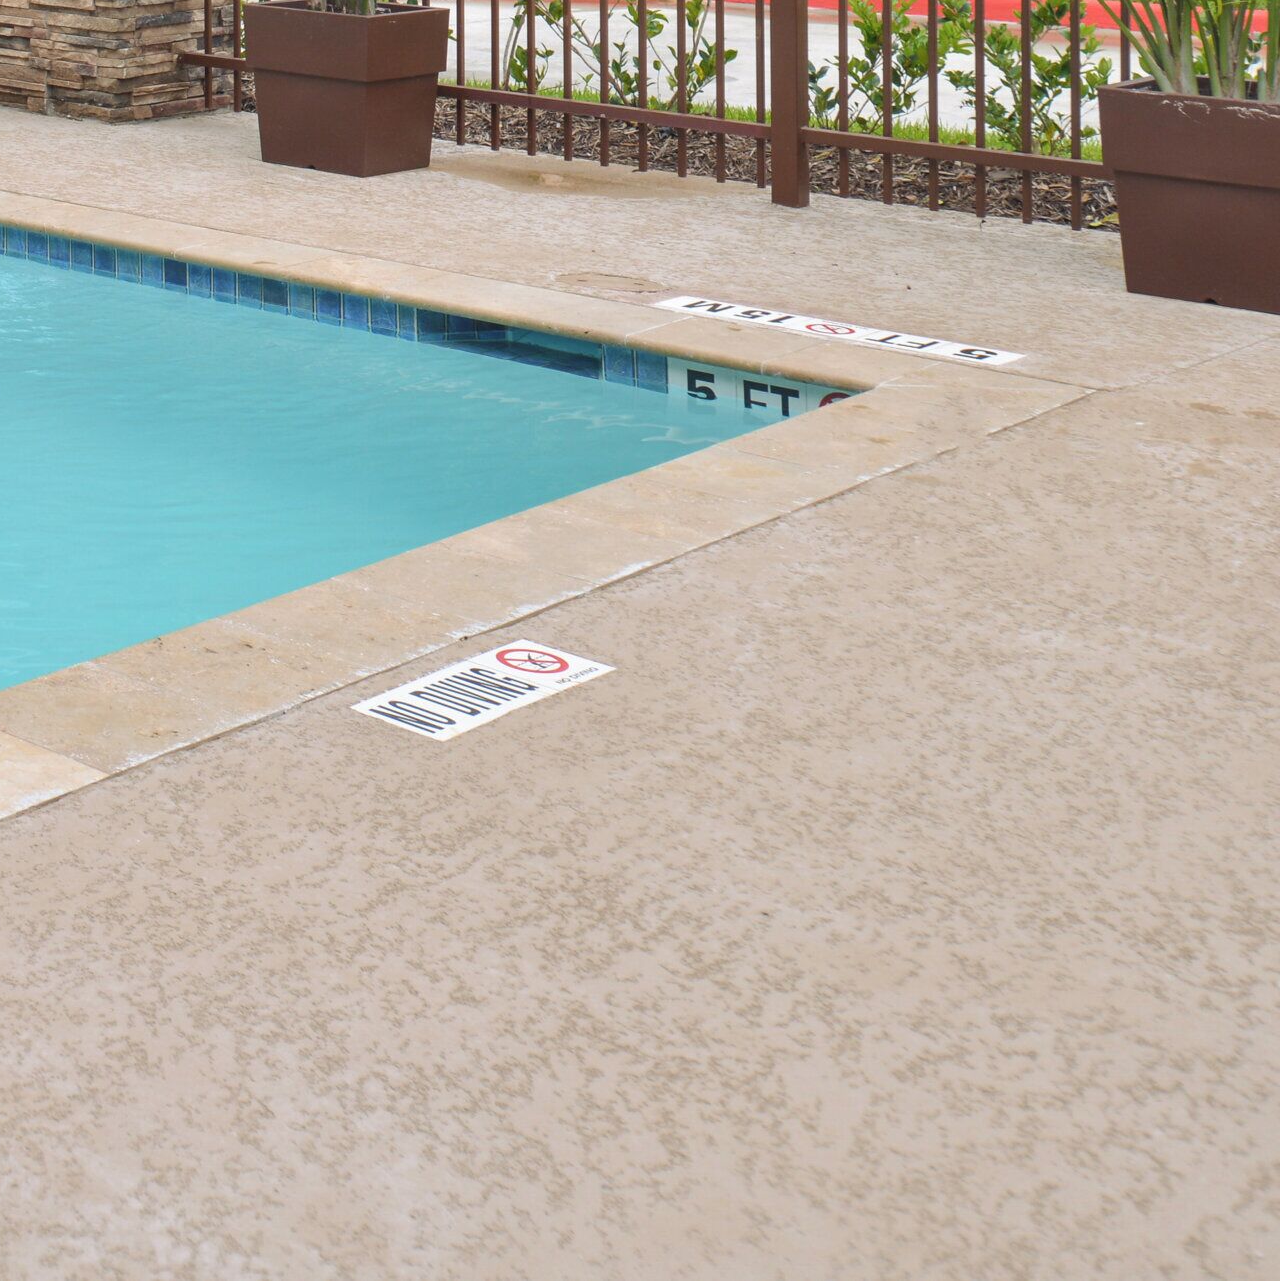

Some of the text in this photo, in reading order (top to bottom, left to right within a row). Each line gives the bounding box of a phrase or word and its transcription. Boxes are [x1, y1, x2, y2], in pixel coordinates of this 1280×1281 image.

[866, 334, 940, 350] FT
[953, 348, 999, 361] 5
[686, 369, 800, 418] 5 FT
[568, 666, 599, 680] DIVING
[369, 666, 540, 734] NO DIVING
